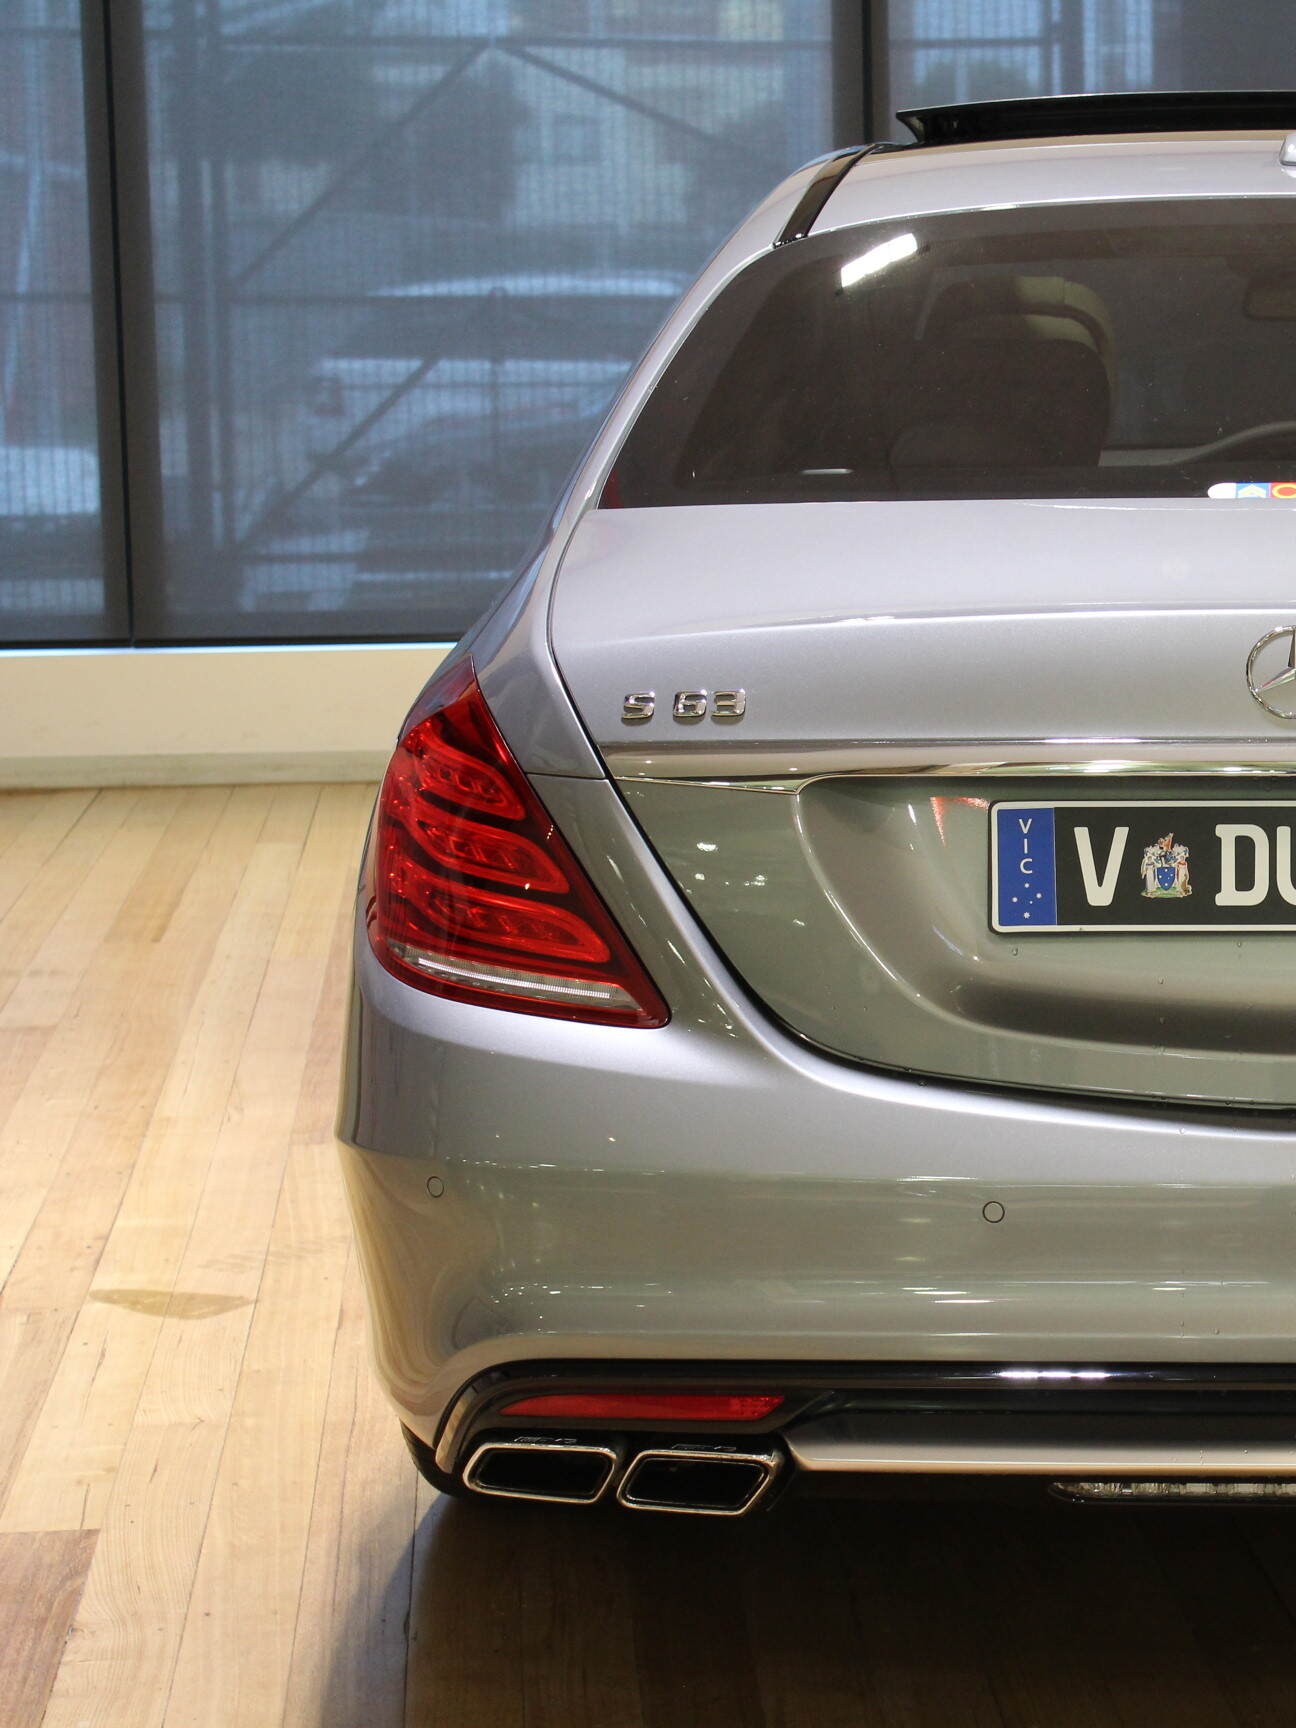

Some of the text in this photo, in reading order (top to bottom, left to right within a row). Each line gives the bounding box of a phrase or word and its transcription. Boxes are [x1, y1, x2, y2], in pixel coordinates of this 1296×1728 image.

[621, 689, 748, 720] S 63
[1018, 818, 1034, 875] VIC
[1073, 826, 1130, 907] V
